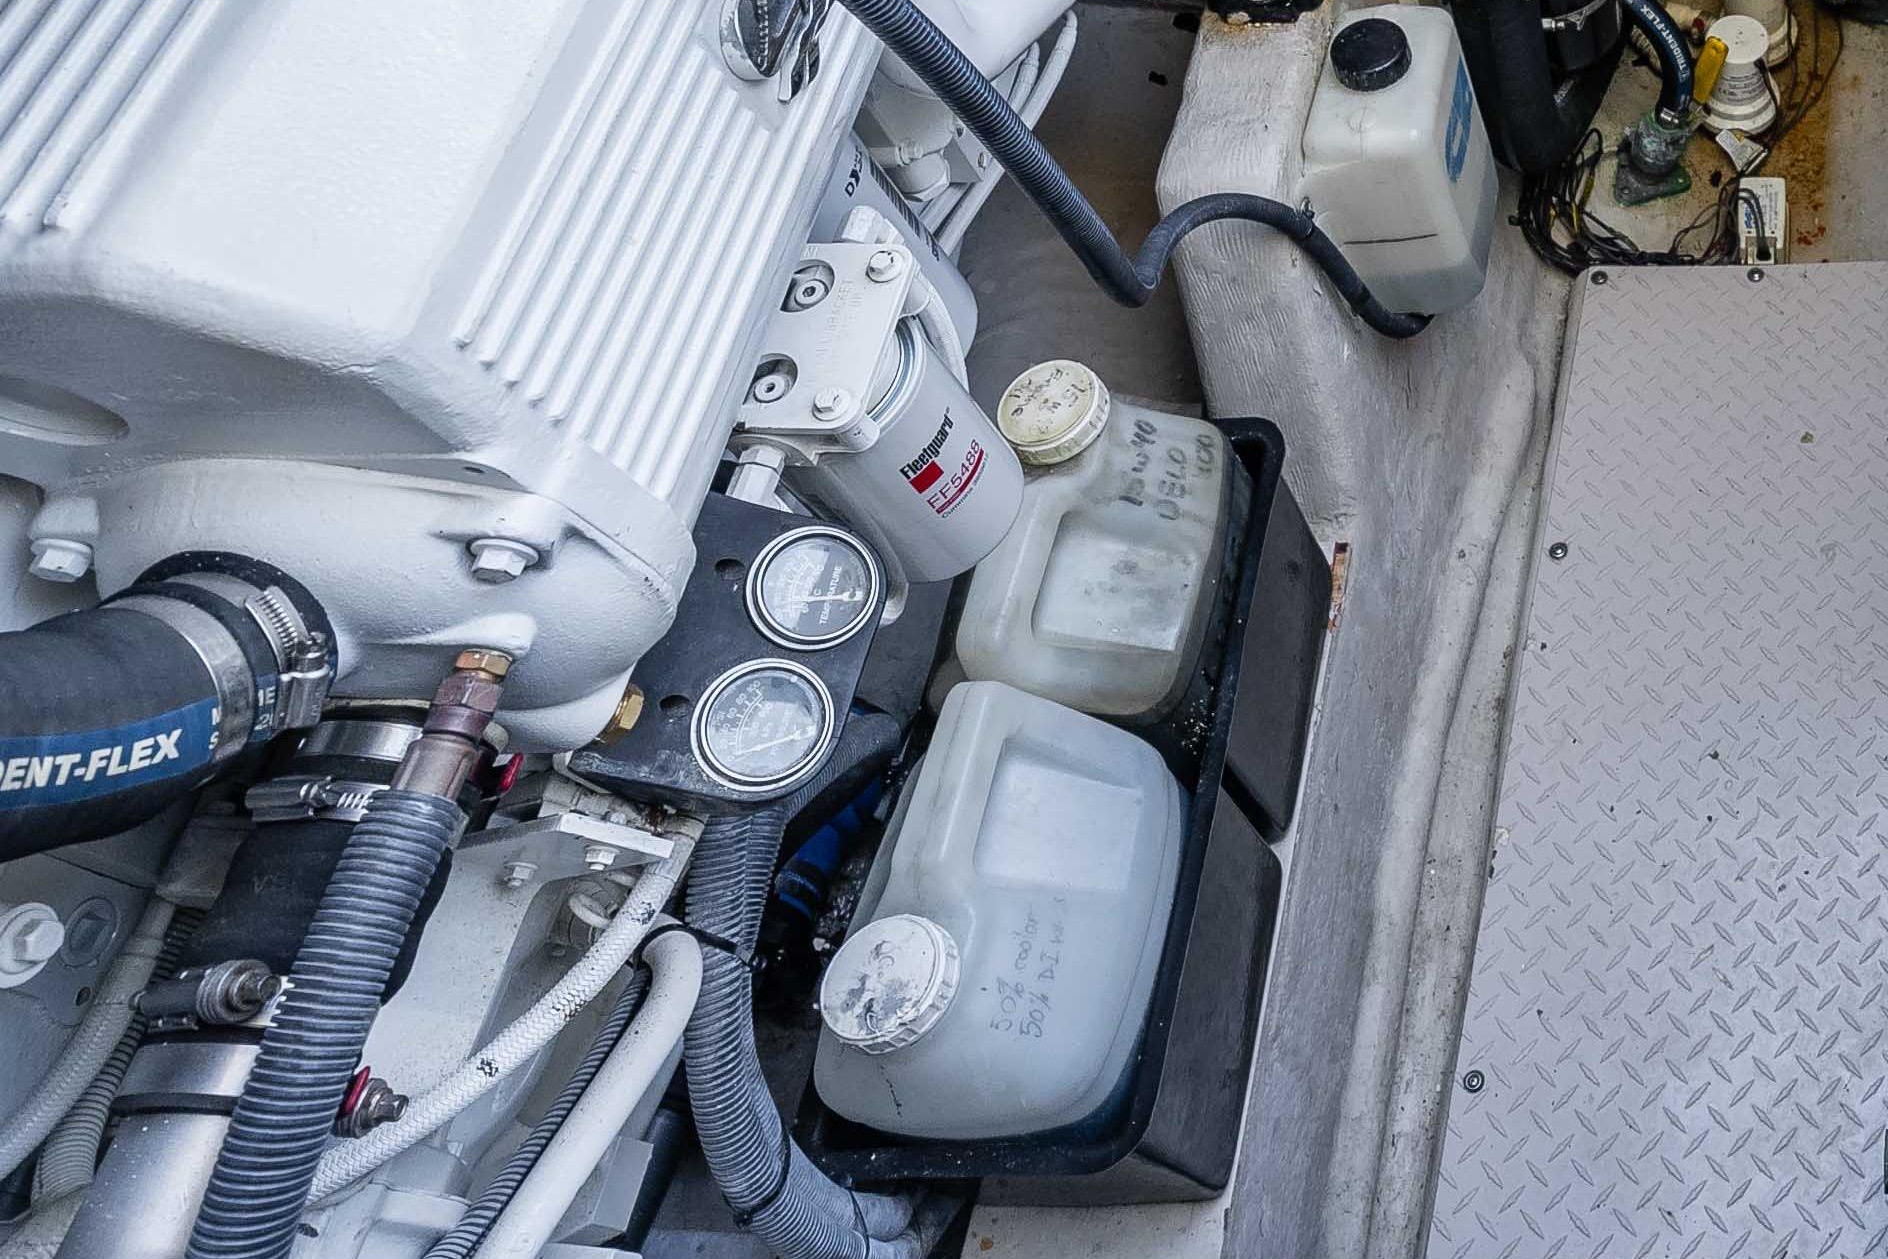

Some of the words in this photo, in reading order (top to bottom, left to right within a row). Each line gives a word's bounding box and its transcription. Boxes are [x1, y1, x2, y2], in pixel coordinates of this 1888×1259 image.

[1641, 4, 1687, 70] TRIDENT-FLEX
[899, 413, 953, 481] Fleetguard
[926, 439, 981, 509] FF5488
[819, 566, 842, 625] TEMPRATURE
[0, 728, 184, 793] ENT-FLEX
